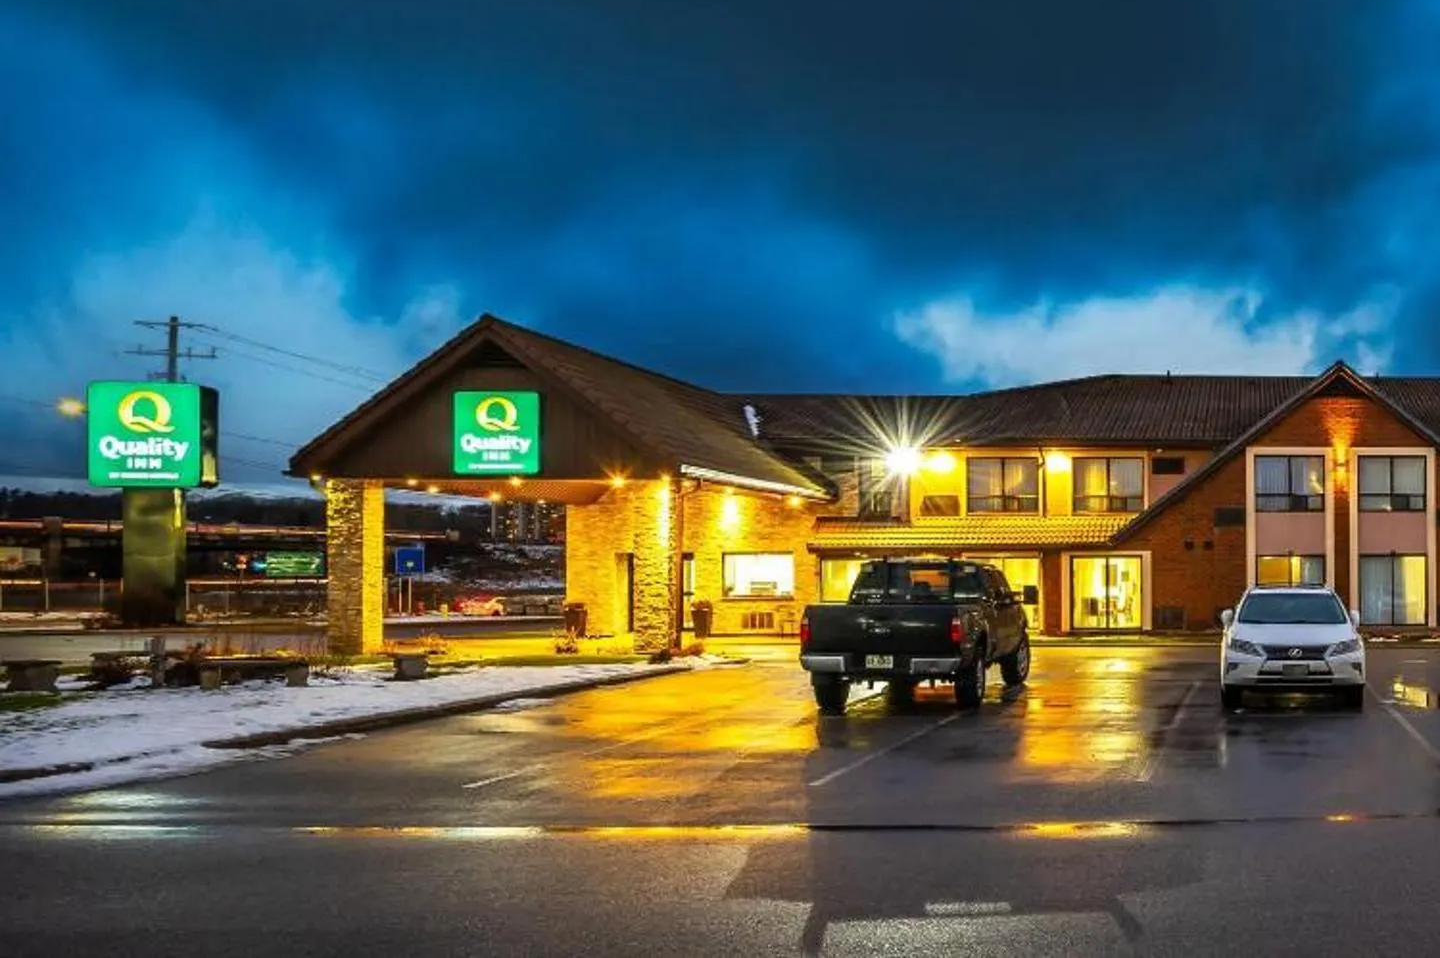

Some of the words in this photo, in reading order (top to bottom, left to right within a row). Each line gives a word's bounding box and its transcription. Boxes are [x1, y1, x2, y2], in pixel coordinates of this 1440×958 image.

[118, 390, 175, 433] Q
[475, 396, 521, 432] Q
[99, 435, 189, 461] Quality
[460, 433, 532, 454] Quality
[126, 457, 162, 469] INN
